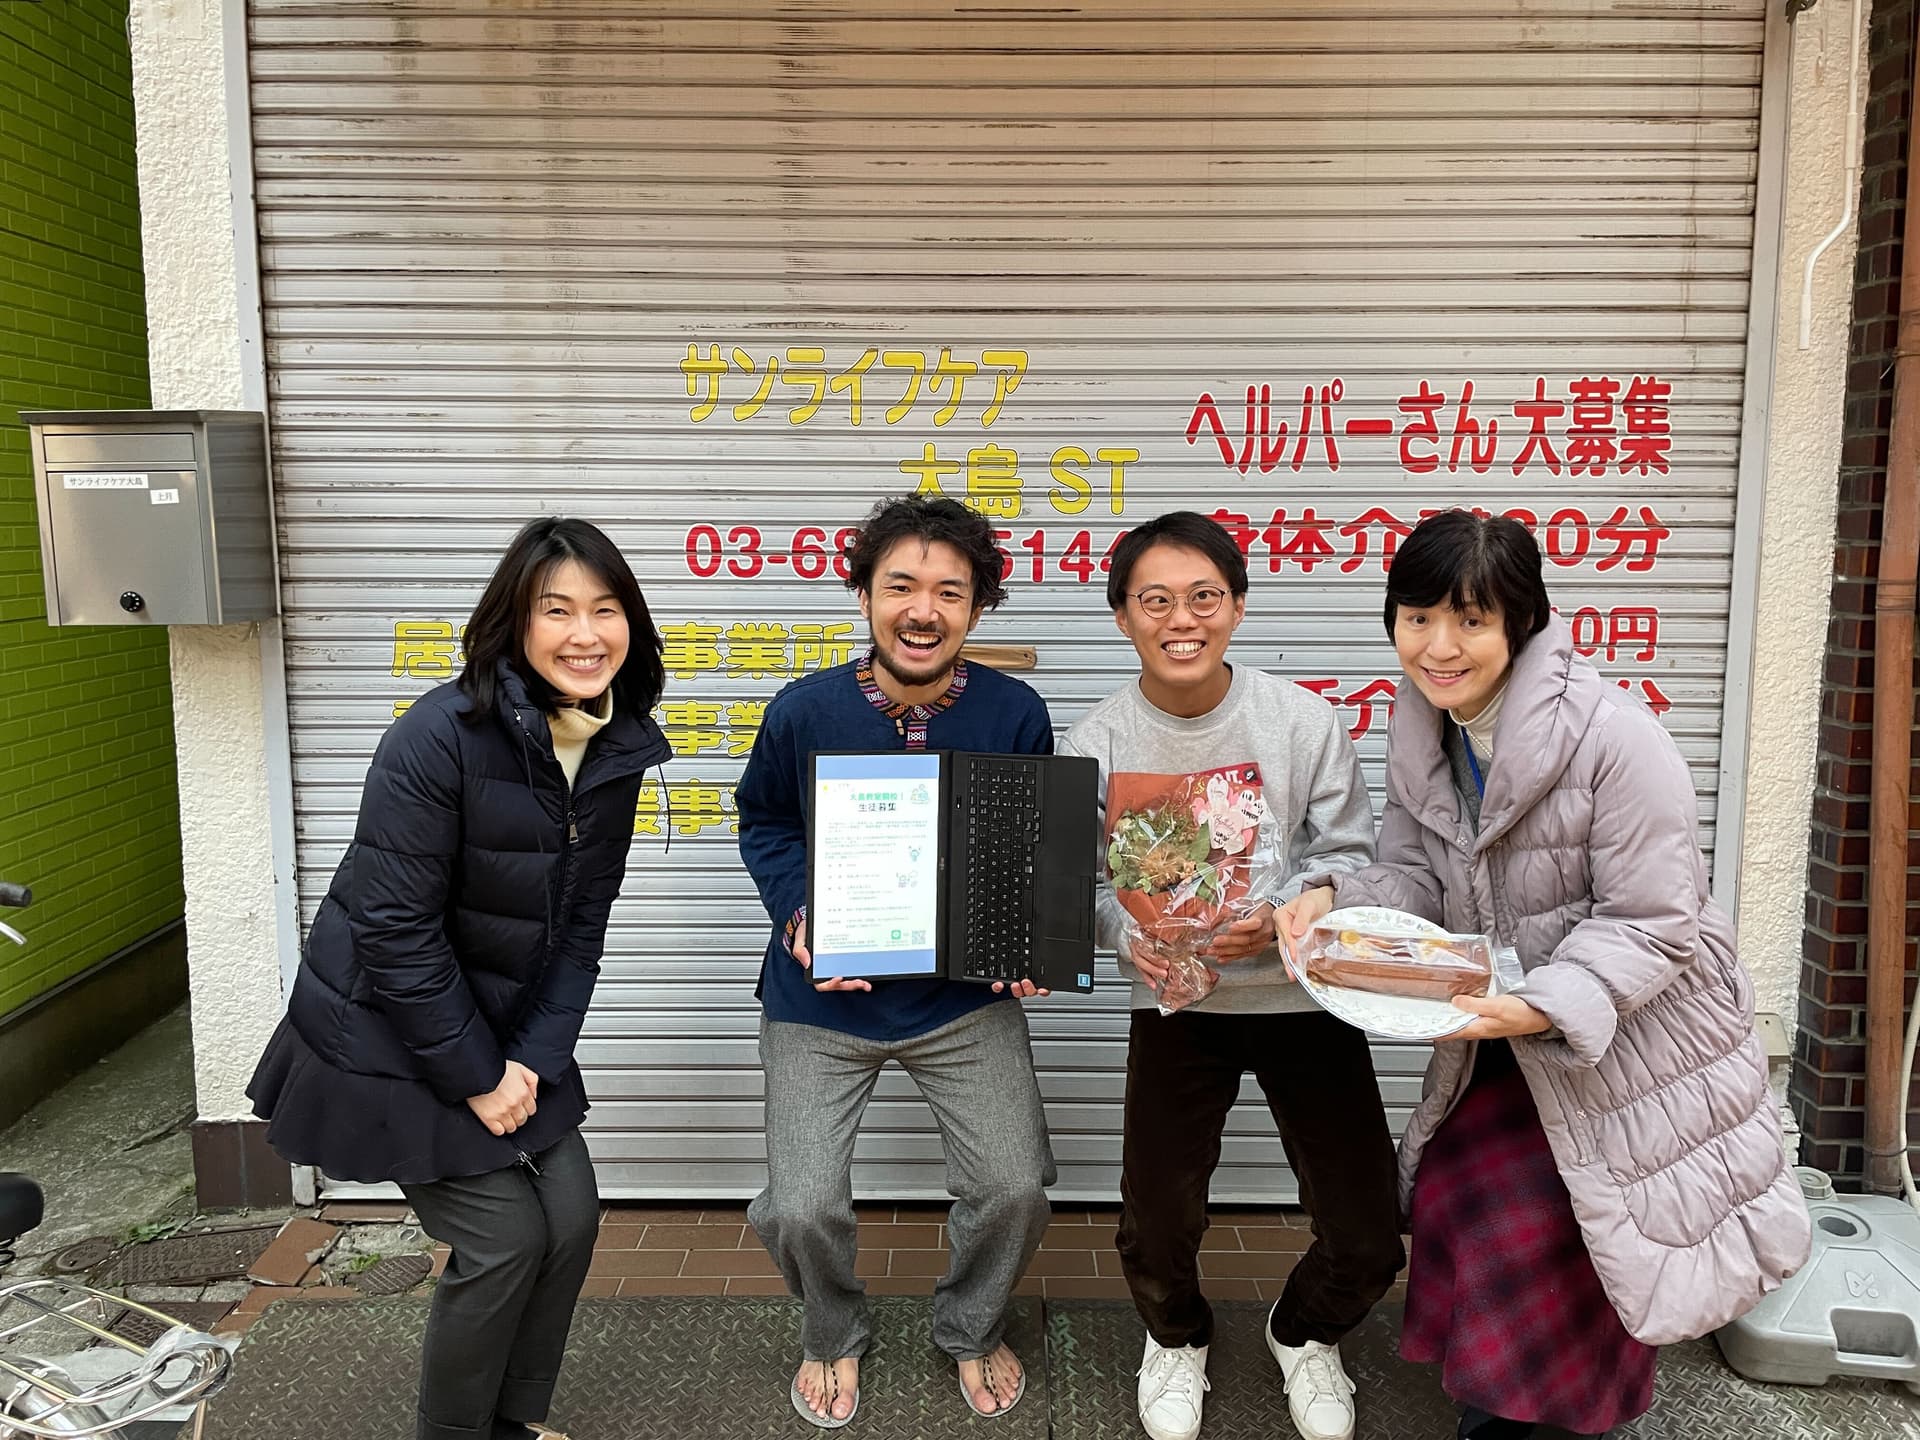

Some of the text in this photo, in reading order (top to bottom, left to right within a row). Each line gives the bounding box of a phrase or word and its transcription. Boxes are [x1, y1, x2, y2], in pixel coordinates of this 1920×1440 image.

[679, 343, 1029, 427] サンライフケア
[70, 477, 143, 486] サンライフケア大島
[898, 442, 1140, 518] 大島 ST
